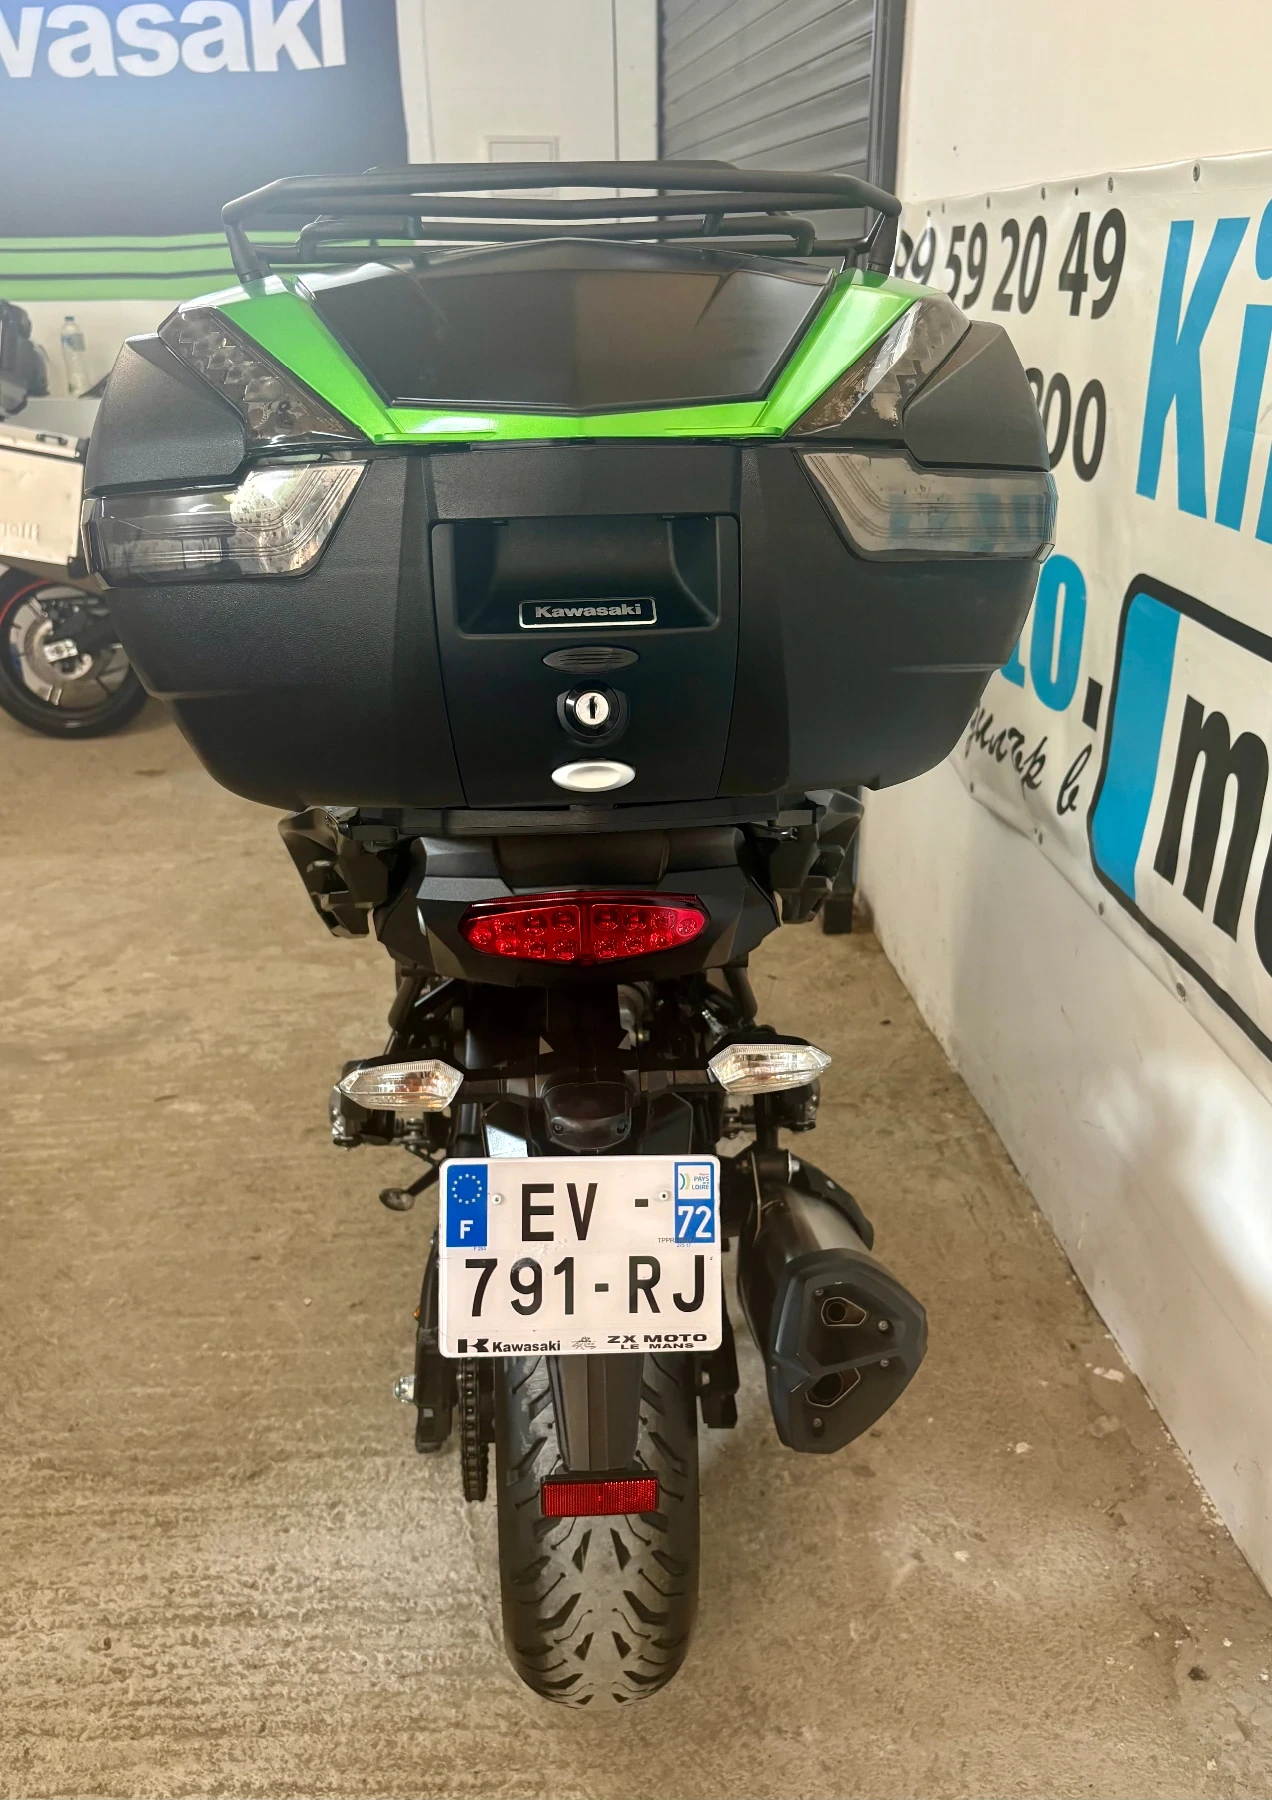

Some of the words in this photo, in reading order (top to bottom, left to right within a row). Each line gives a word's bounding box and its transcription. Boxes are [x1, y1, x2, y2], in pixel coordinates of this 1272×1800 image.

[945, 221, 988, 310] 59
[991, 215, 1047, 314] 20
[1058, 207, 1127, 320] 49
[1136, 198, 1272, 546] Ki
[534, 603, 642, 618] Kawasaki
[521, 1182, 598, 1242] EV
[677, 1205, 712, 1239] 72
[459, 1219, 474, 1240] F
[465, 1254, 705, 1318] 791-RJ
[491, 1340, 562, 1353] Kawasaki
[607, 1335, 637, 1344] ZX
[643, 1333, 708, 1343] MOTO
[648, 1342, 695, 1350] MANS
